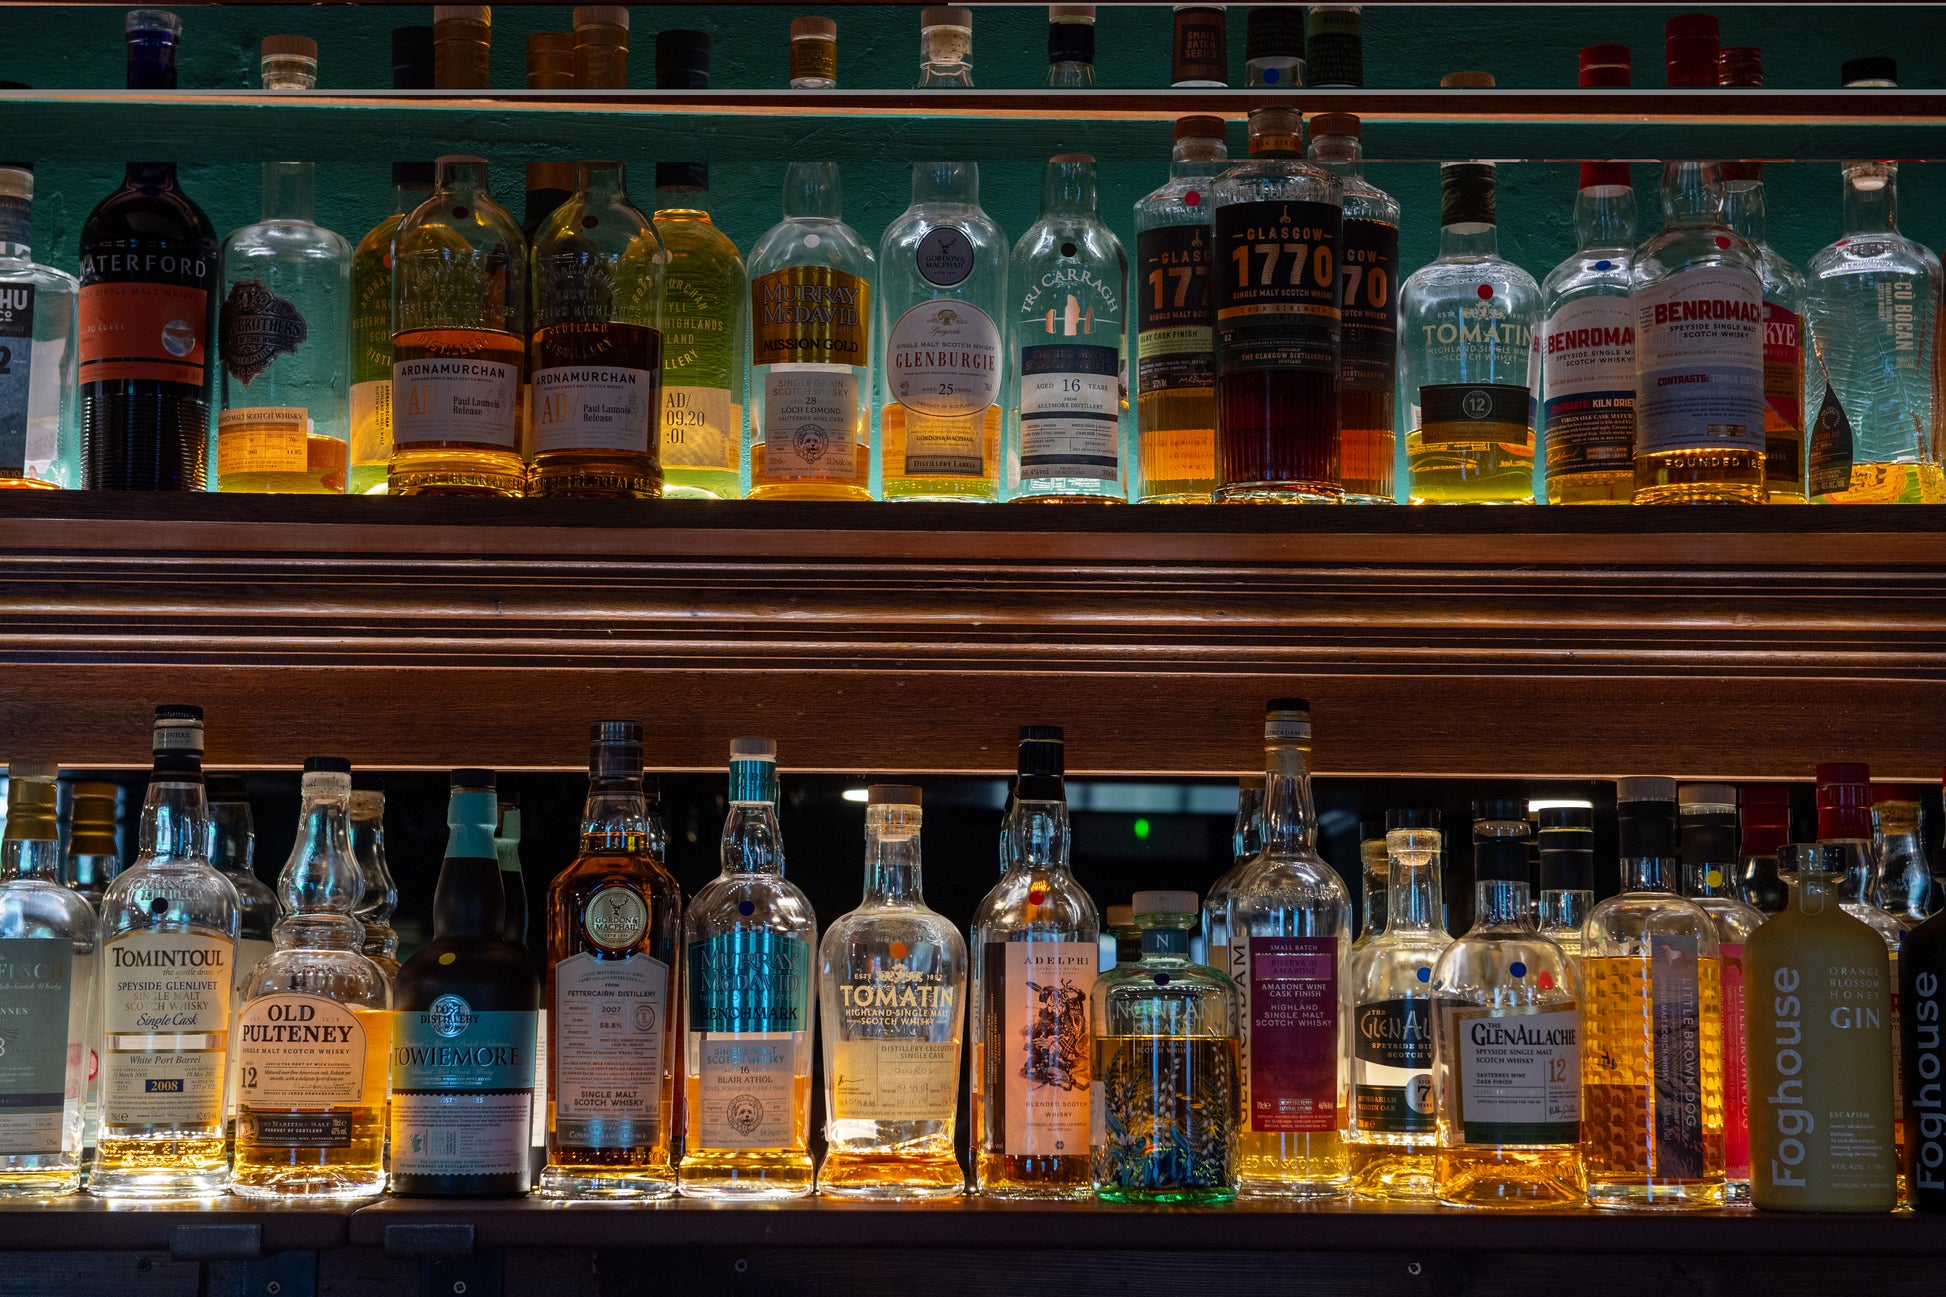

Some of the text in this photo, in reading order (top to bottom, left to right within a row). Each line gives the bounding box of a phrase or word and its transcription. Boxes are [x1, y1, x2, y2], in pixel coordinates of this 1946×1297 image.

[1187, 31, 1216, 41] SMALL
[1247, 228, 1323, 242] GLASGOW
[925, 261, 966, 270] MACPHAIL
[1232, 243, 1333, 287] 1770
[763, 283, 860, 304] MURRAY
[1020, 268, 1118, 313] TRI CARRAGH
[1232, 290, 1257, 299] SINGLE
[1281, 289, 1309, 297] SCOTCH
[1172, 310, 1191, 318] MALT
[1240, 306, 1267, 314] CASK
[664, 318, 723, 331] HIGHLANDS
[1669, 323, 1741, 332] SPEYSIDE SINGLE
[1154, 330, 1198, 340] CASK FINISH
[1422, 323, 1532, 347] TOMATIN
[1683, 330, 1749, 339] SCOTCH WHISKY
[764, 338, 859, 353] MISSION GOLD
[896, 342, 919, 350] SINGLE
[973, 343, 995, 351] WHISKY
[1429, 345, 1511, 354] HIGHLAND SINGLE
[896, 351, 995, 371] GLENBURGIE
[1241, 352, 1325, 361] THE GLASGOW DISTILLERY
[1444, 353, 1517, 362] SCOTCH WHISKY
[1556, 352, 1588, 361] SPEYSIDE
[1566, 359, 1596, 367] SCOTCH
[401, 363, 505, 380] ARDNAMURCHAN
[536, 371, 636, 386] ARDNAMURCHAN
[1658, 374, 1709, 386] CONTRASTS:
[939, 383, 954, 395] 25
[1036, 378, 1109, 393] AGED 16 YEARS
[773, 388, 812, 398] SCOTCH
[453, 396, 500, 409] Paul Launois
[667, 392, 691, 408] AD/
[805, 396, 817, 405] 28
[1469, 399, 1485, 411] 12
[1592, 399, 1612, 408] KILN
[452, 406, 483, 416] Release
[583, 403, 631, 415] Paul Launois
[781, 406, 841, 415] LOCH LOMOND
[246, 412, 303, 421] SCOTCH WHISKY
[583, 413, 613, 423] Release
[666, 411, 705, 427] 09.20
[1665, 457, 1740, 468] FOUNDED
[595, 923, 639, 931] MACPHAIL
[1156, 934, 1169, 948] N
[112, 948, 225, 967] TOMINTOUL
[700, 950, 799, 970] MURRAY
[1023, 956, 1089, 965] ADELPHI
[163, 968, 175, 976] the
[1273, 967, 1316, 975] AMARONE
[1829, 967, 1880, 976] ORANGE
[118, 981, 218, 991] SPEYSIDE GLENLIVET
[1830, 979, 1880, 988] BLOSSOM
[134, 992, 169, 1001] SINGLE
[840, 985, 954, 1007] TOMATIN
[1830, 990, 1880, 1000] HONEY
[125, 1001, 209, 1011] SCOTCH WHISKY
[434, 1004, 462, 1014] LOST
[268, 1004, 316, 1021] OLD
[702, 1007, 798, 1021] BENCHMARK
[845, 1009, 949, 1017] HIGHLAND SINGLE MALT
[136, 1013, 198, 1030] Single Cask
[420, 1014, 480, 1024] DISTILLERY
[861, 1017, 935, 1025] SCOTCH WHISKY
[1830, 1006, 1881, 1030] GIN
[242, 1025, 353, 1043] PULTENEY
[714, 1047, 777, 1055] SINGLE MALT
[1682, 978, 1697, 1128] LITTLE BROWN DOG
[130, 1055, 202, 1064] White Port Barrel
[394, 1047, 522, 1067] TOWIEMORE
[707, 1056, 784, 1064] SCOTCH WHISKY
[740, 1066, 750, 1074] 16
[1549, 1058, 1567, 1083] 12
[241, 1067, 258, 1089] 12
[717, 1076, 773, 1084] BLAIR ATHOL
[1768, 967, 1815, 1188] Foghouse
[1912, 971, 1946, 1190] Foghouse
[151, 1080, 178, 1091] 2008
[1417, 1085, 1432, 1102] 7
